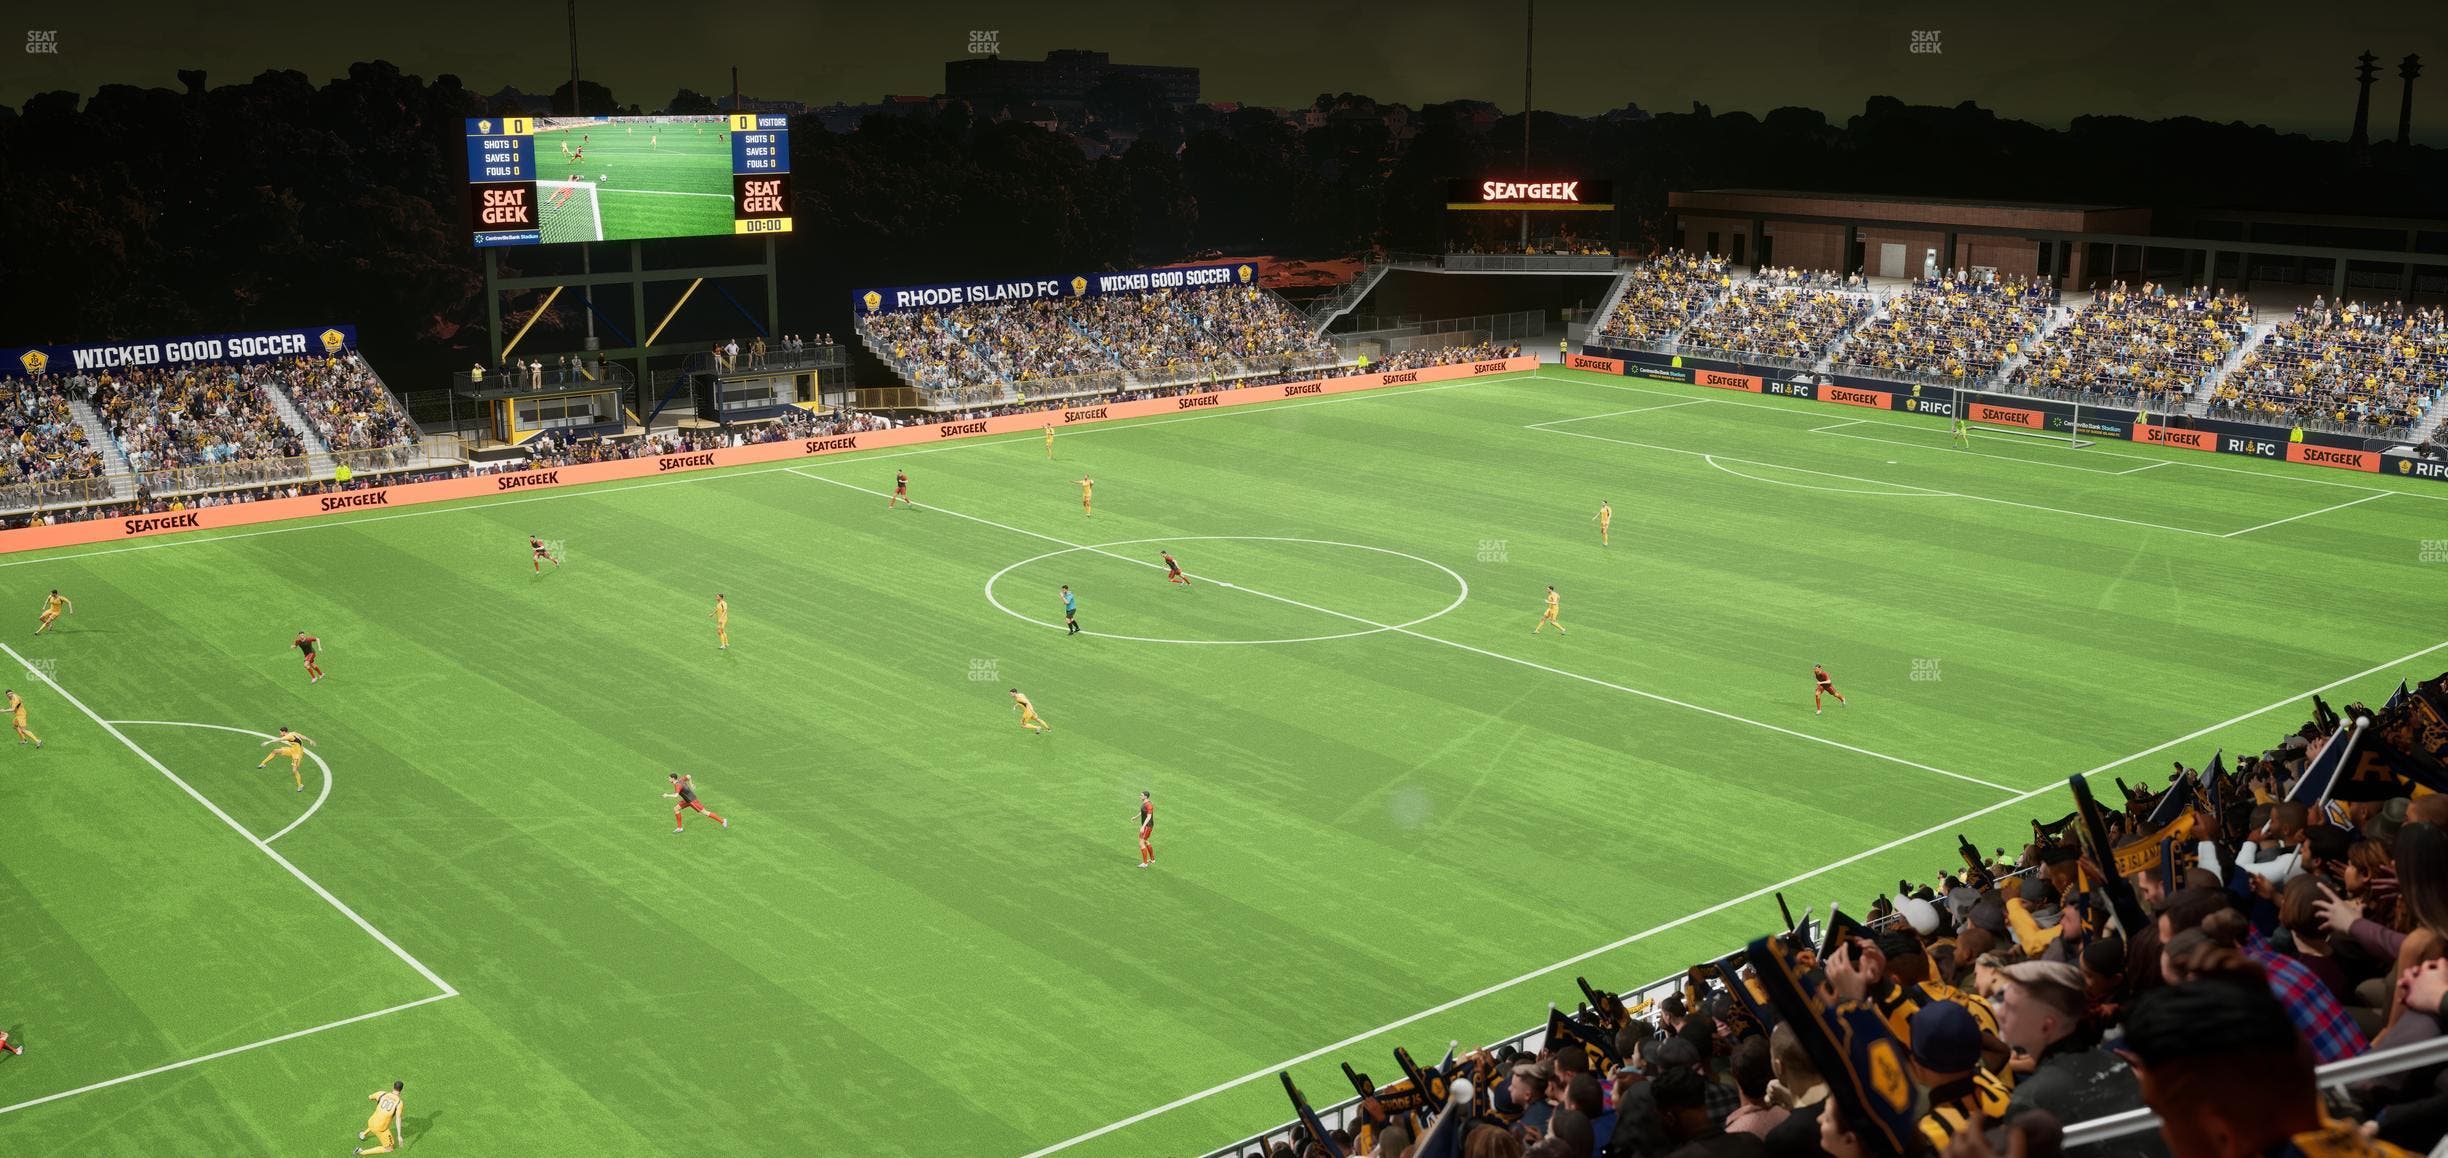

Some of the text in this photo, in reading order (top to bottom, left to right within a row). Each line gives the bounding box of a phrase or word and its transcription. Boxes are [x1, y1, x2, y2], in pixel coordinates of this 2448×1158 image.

[514, 119, 523, 134] 0
[740, 116, 786, 130] 0 VISITORS
[484, 139, 519, 149] SHOTS 0
[745, 134, 775, 144] SHOTS 0
[485, 152, 519, 163] SAVES 0
[746, 147, 775, 156] SAVES 0
[486, 165, 520, 176] FOULS 0
[746, 159, 776, 169] FOULS 0
[744, 180, 781, 197] SEAT
[1483, 181, 1579, 201] SEATGEEK
[483, 188, 526, 207] SEAT
[743, 196, 784, 213] GEEK
[482, 206, 529, 224] GEEK
[746, 219, 782, 232] 00:00
[1100, 268, 1231, 292] WICKED GOOD SOCCER
[896, 280, 1059, 308] RHODE ISLAND FC
[72, 333, 307, 370] WICKED GOOD SOCCER
[1475, 362, 1506, 375] SEATGEEK
[1574, 357, 1612, 372] SEATGEEK
[1383, 371, 1418, 385] SEATGEEK
[1707, 374, 1750, 390] SEATGEEK
[1285, 383, 1322, 397] SEATGEEK
[1772, 382, 1808, 397] RI FC
[1830, 389, 1878, 406] SEATGEEK
[1179, 395, 1218, 409] SEATGEEK
[1920, 400, 1951, 415] RIFC
[1064, 407, 1108, 423] SEATGEEK
[1982, 408, 2030, 425] SEATGEEK
[940, 421, 988, 438] SEATGEEK
[2147, 428, 2201, 447] SEATGEEK
[806, 437, 856, 453] SEATGEEK
[2229, 439, 2275, 456] RI FC
[659, 452, 715, 471] SEATGEEK
[2303, 448, 2362, 468] SEATGEEK
[498, 471, 559, 490] SEATGEEK
[321, 490, 388, 511] SEATGEEK
[125, 512, 200, 534] SEATGEEK
